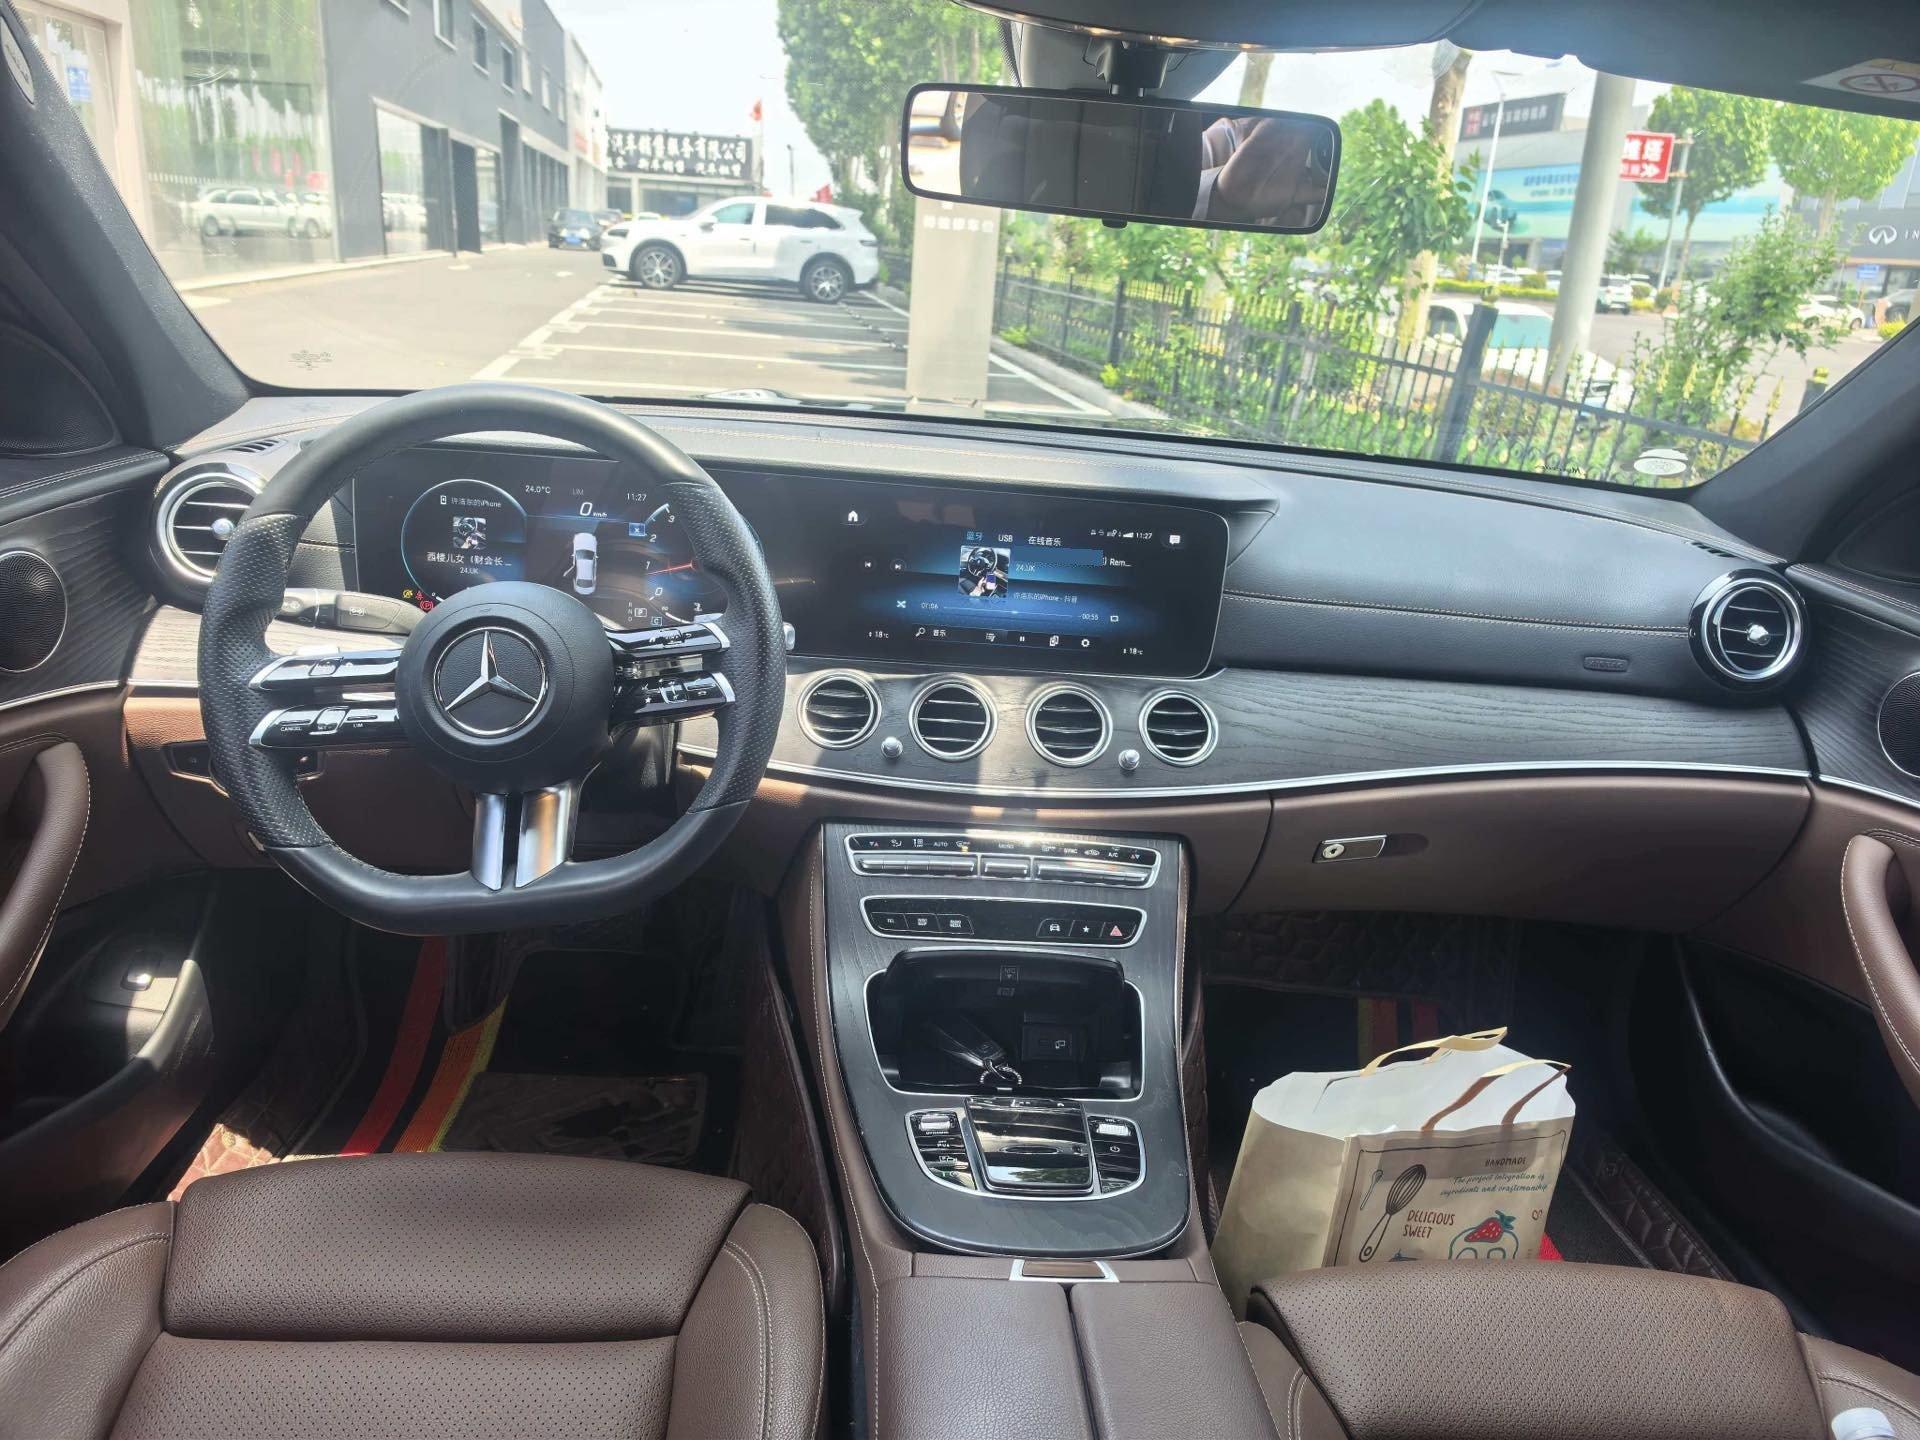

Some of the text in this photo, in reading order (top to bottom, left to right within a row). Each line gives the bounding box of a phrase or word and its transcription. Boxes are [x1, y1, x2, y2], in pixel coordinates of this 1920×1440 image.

[626, 492, 648, 502] 11:27
[580, 501, 593, 517] 0
[998, 533, 1014, 543] USB
[1027, 535, 1062, 547] 在线音乐
[1136, 531, 1153, 540] 11:27
[1484, 1156, 1527, 1167] HANDMADE
[1481, 1184, 1497, 1193] and
[1407, 1209, 1456, 1226] DELICIOUS
[1402, 1224, 1433, 1239] SWEET
